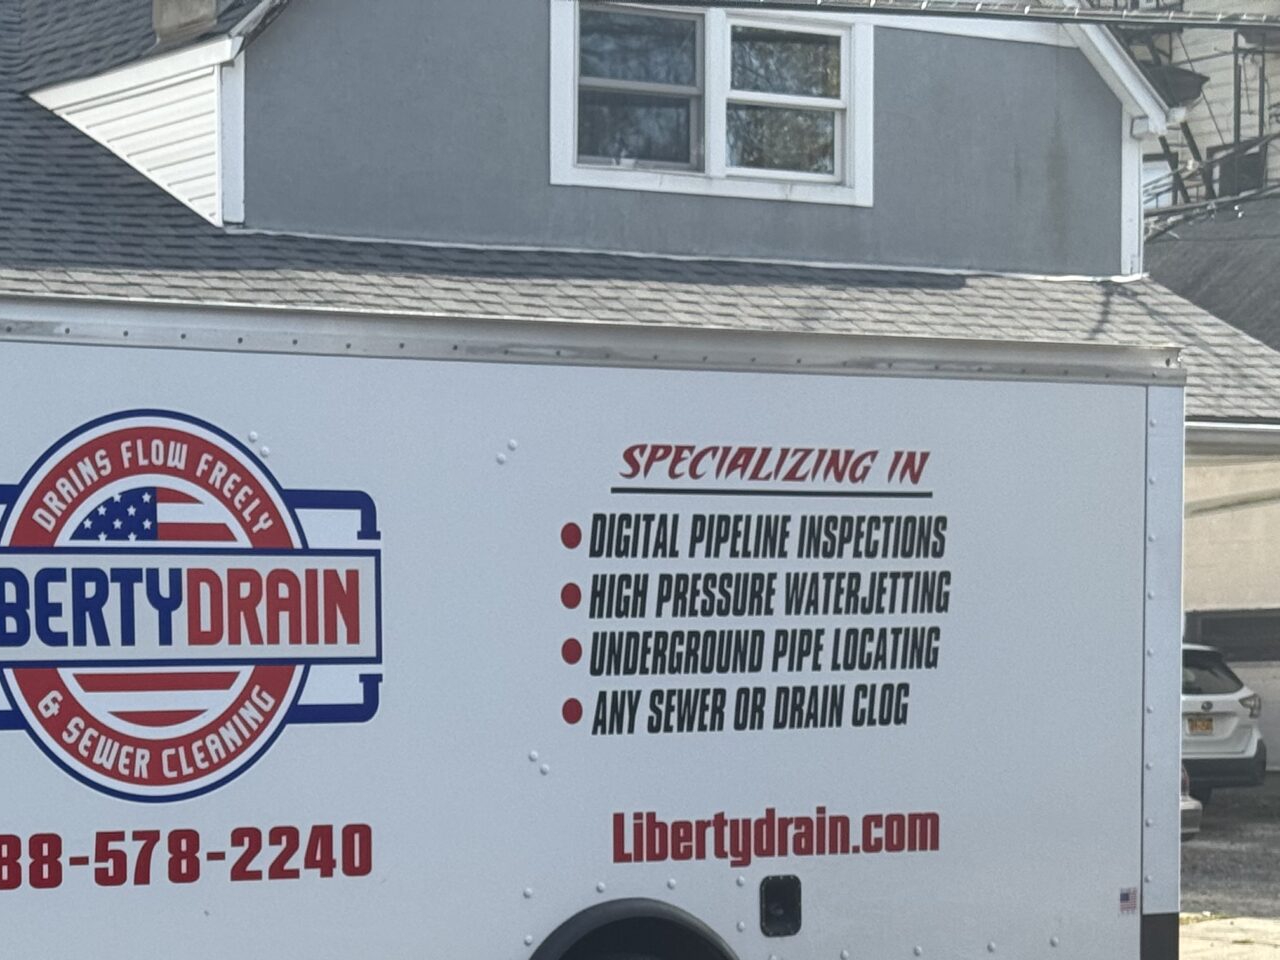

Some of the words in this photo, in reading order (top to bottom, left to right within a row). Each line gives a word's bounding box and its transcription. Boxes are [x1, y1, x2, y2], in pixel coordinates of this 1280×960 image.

[32, 449, 113, 533] DRAINS
[120, 438, 188, 470] FLOW
[195, 453, 273, 534] FREELY
[619, 443, 879, 484] SPECIALIZING
[888, 451, 931, 485] IN
[589, 513, 680, 559] DIGITAL
[688, 514, 792, 559] PIPELINE
[797, 515, 948, 559] INSPECTIONS
[589, 574, 649, 618] HIGH
[656, 572, 778, 618] PRESSURE
[784, 570, 952, 616] WATERJETTING
[589, 629, 765, 676] UNDERGROUND
[772, 628, 824, 672] PIPE
[831, 626, 941, 671] LOCATING
[37, 690, 63, 719] &
[61, 716, 151, 779] SEWER
[161, 684, 275, 778] CLEANING
[591, 690, 642, 735] ANY
[647, 688, 726, 734] SEWER
[733, 686, 767, 731] OR
[773, 684, 845, 729] DRAIN
[851, 682, 910, 727] CLOG
[612, 806, 940, 868] Libertydrain.com
